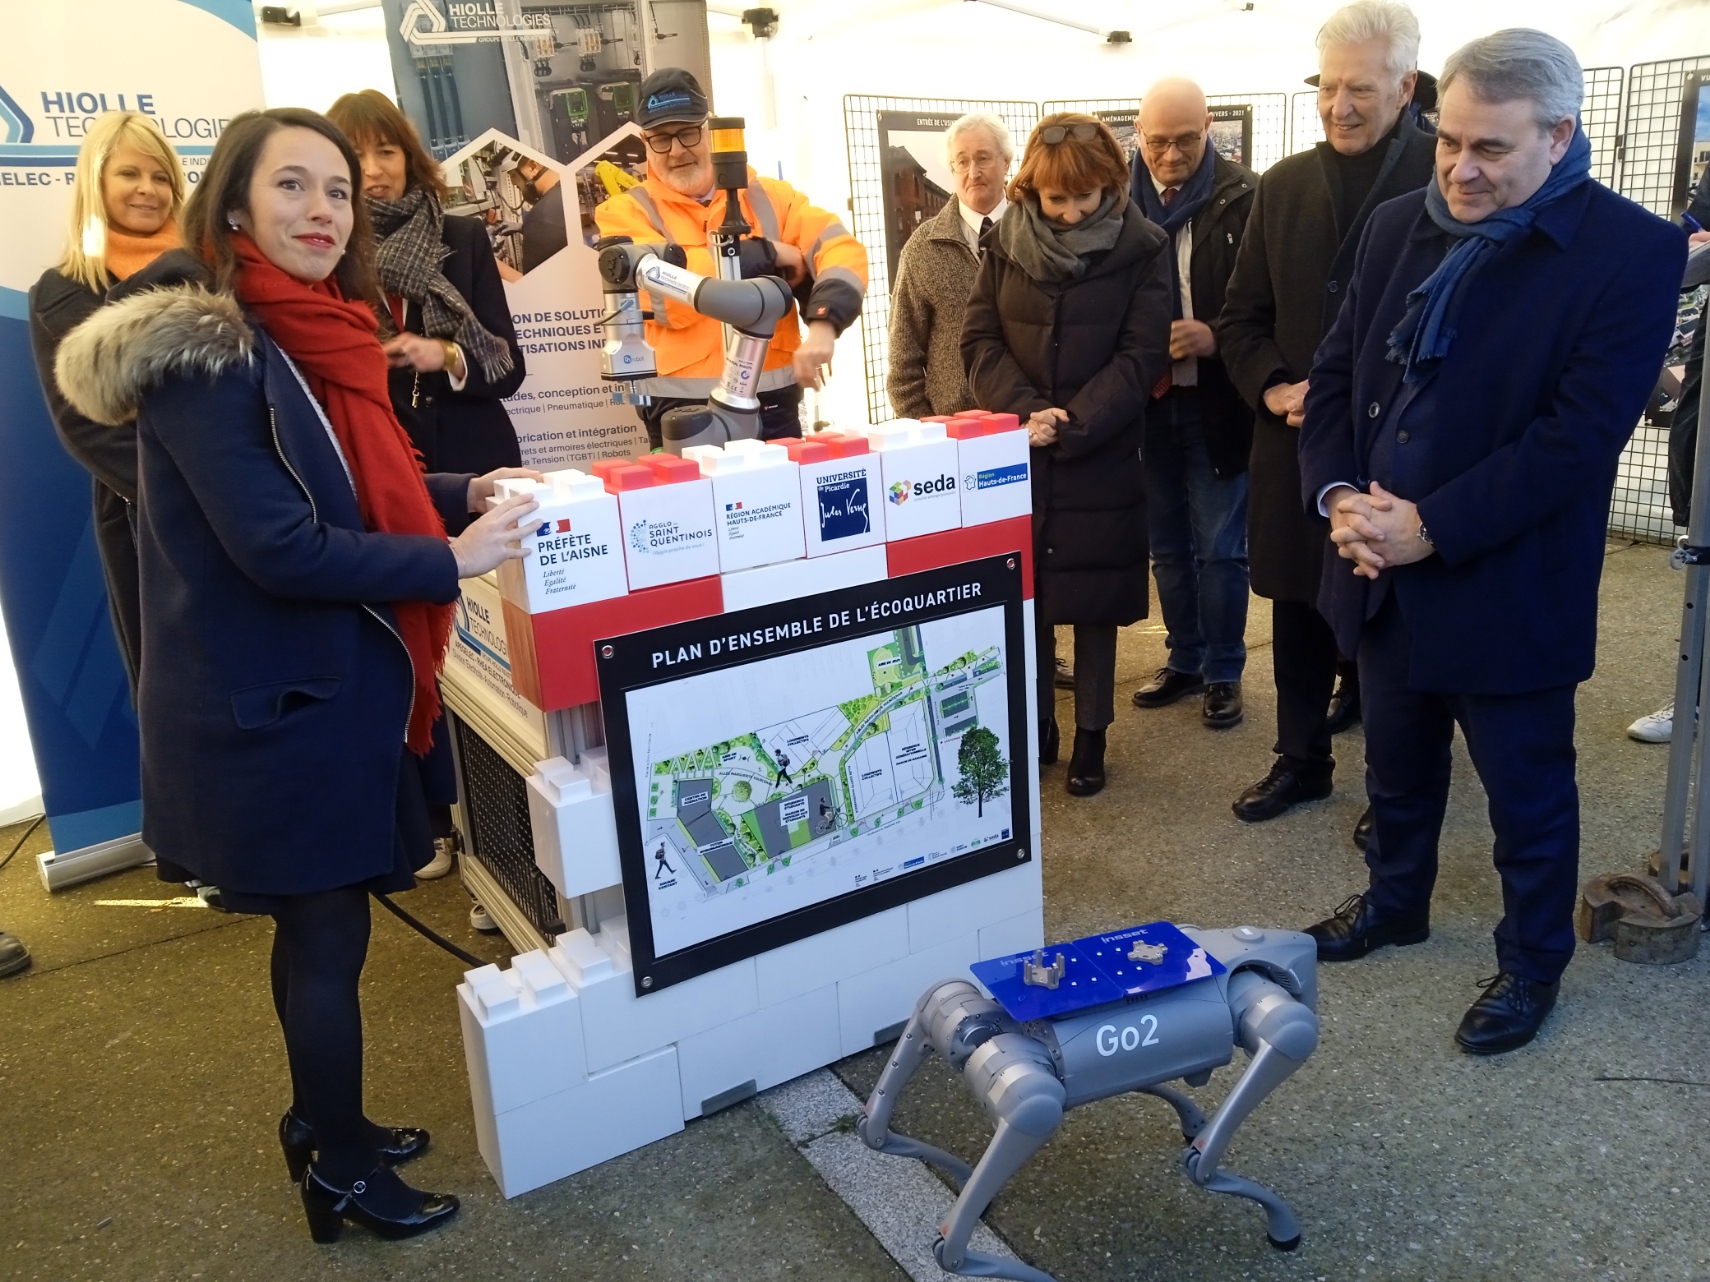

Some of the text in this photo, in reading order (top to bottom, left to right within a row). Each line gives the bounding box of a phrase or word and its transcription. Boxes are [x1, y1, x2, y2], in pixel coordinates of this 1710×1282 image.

[449, 3, 503, 15] HIOLLE
[450, 14, 550, 28] TECHNOLOGIES
[41, 91, 155, 114] HIOLLE
[916, 117, 933, 126] ENTRÉE
[0, 172, 51, 186] ELEC
[512, 313, 531, 324] ON
[534, 312, 552, 322] DE
[515, 325, 591, 339] ECHNIQUES
[518, 341, 586, 354] TISATIONS
[538, 386, 600, 399] conception
[602, 384, 613, 393] et
[506, 404, 541, 416] ectrique
[547, 400, 604, 411] Pneumatique
[565, 430, 577, 439] et
[579, 424, 637, 439] intégration
[520, 447, 537, 456] rets
[538, 446, 547, 454] et
[549, 441, 586, 453] armoires
[586, 438, 633, 450] électriques
[532, 455, 565, 466] Tension
[566, 452, 596, 463] (TGBT)
[602, 448, 631, 459] Robots
[816, 467, 867, 484] UNIVERSITÉ
[979, 472, 995, 480] Région
[979, 473, 1027, 488] Hauts-de-France
[825, 483, 850, 492] Picardie
[914, 474, 955, 496] seda
[726, 502, 791, 519] RÉGION ACADÉMIQUE
[820, 488, 868, 533] Jules Verne
[649, 521, 672, 530] AGGLO
[727, 511, 783, 526] HAUTS-DE-FRANCE
[649, 526, 679, 539] SAINT
[650, 528, 712, 547] QUENTINOIS
[538, 533, 592, 553] PRÉFÈTE
[539, 544, 608, 566] DE L'AISNE
[543, 568, 565, 578] Liberté
[545, 583, 577, 595] Fraternité
[466, 596, 491, 626] HIOLLE
[652, 582, 982, 669] PLAN D'ENSEMBLE DE L'ÉCOQUARTIER
[1000, 951, 1049, 967] insst
[1096, 1014, 1160, 1057] Go2
